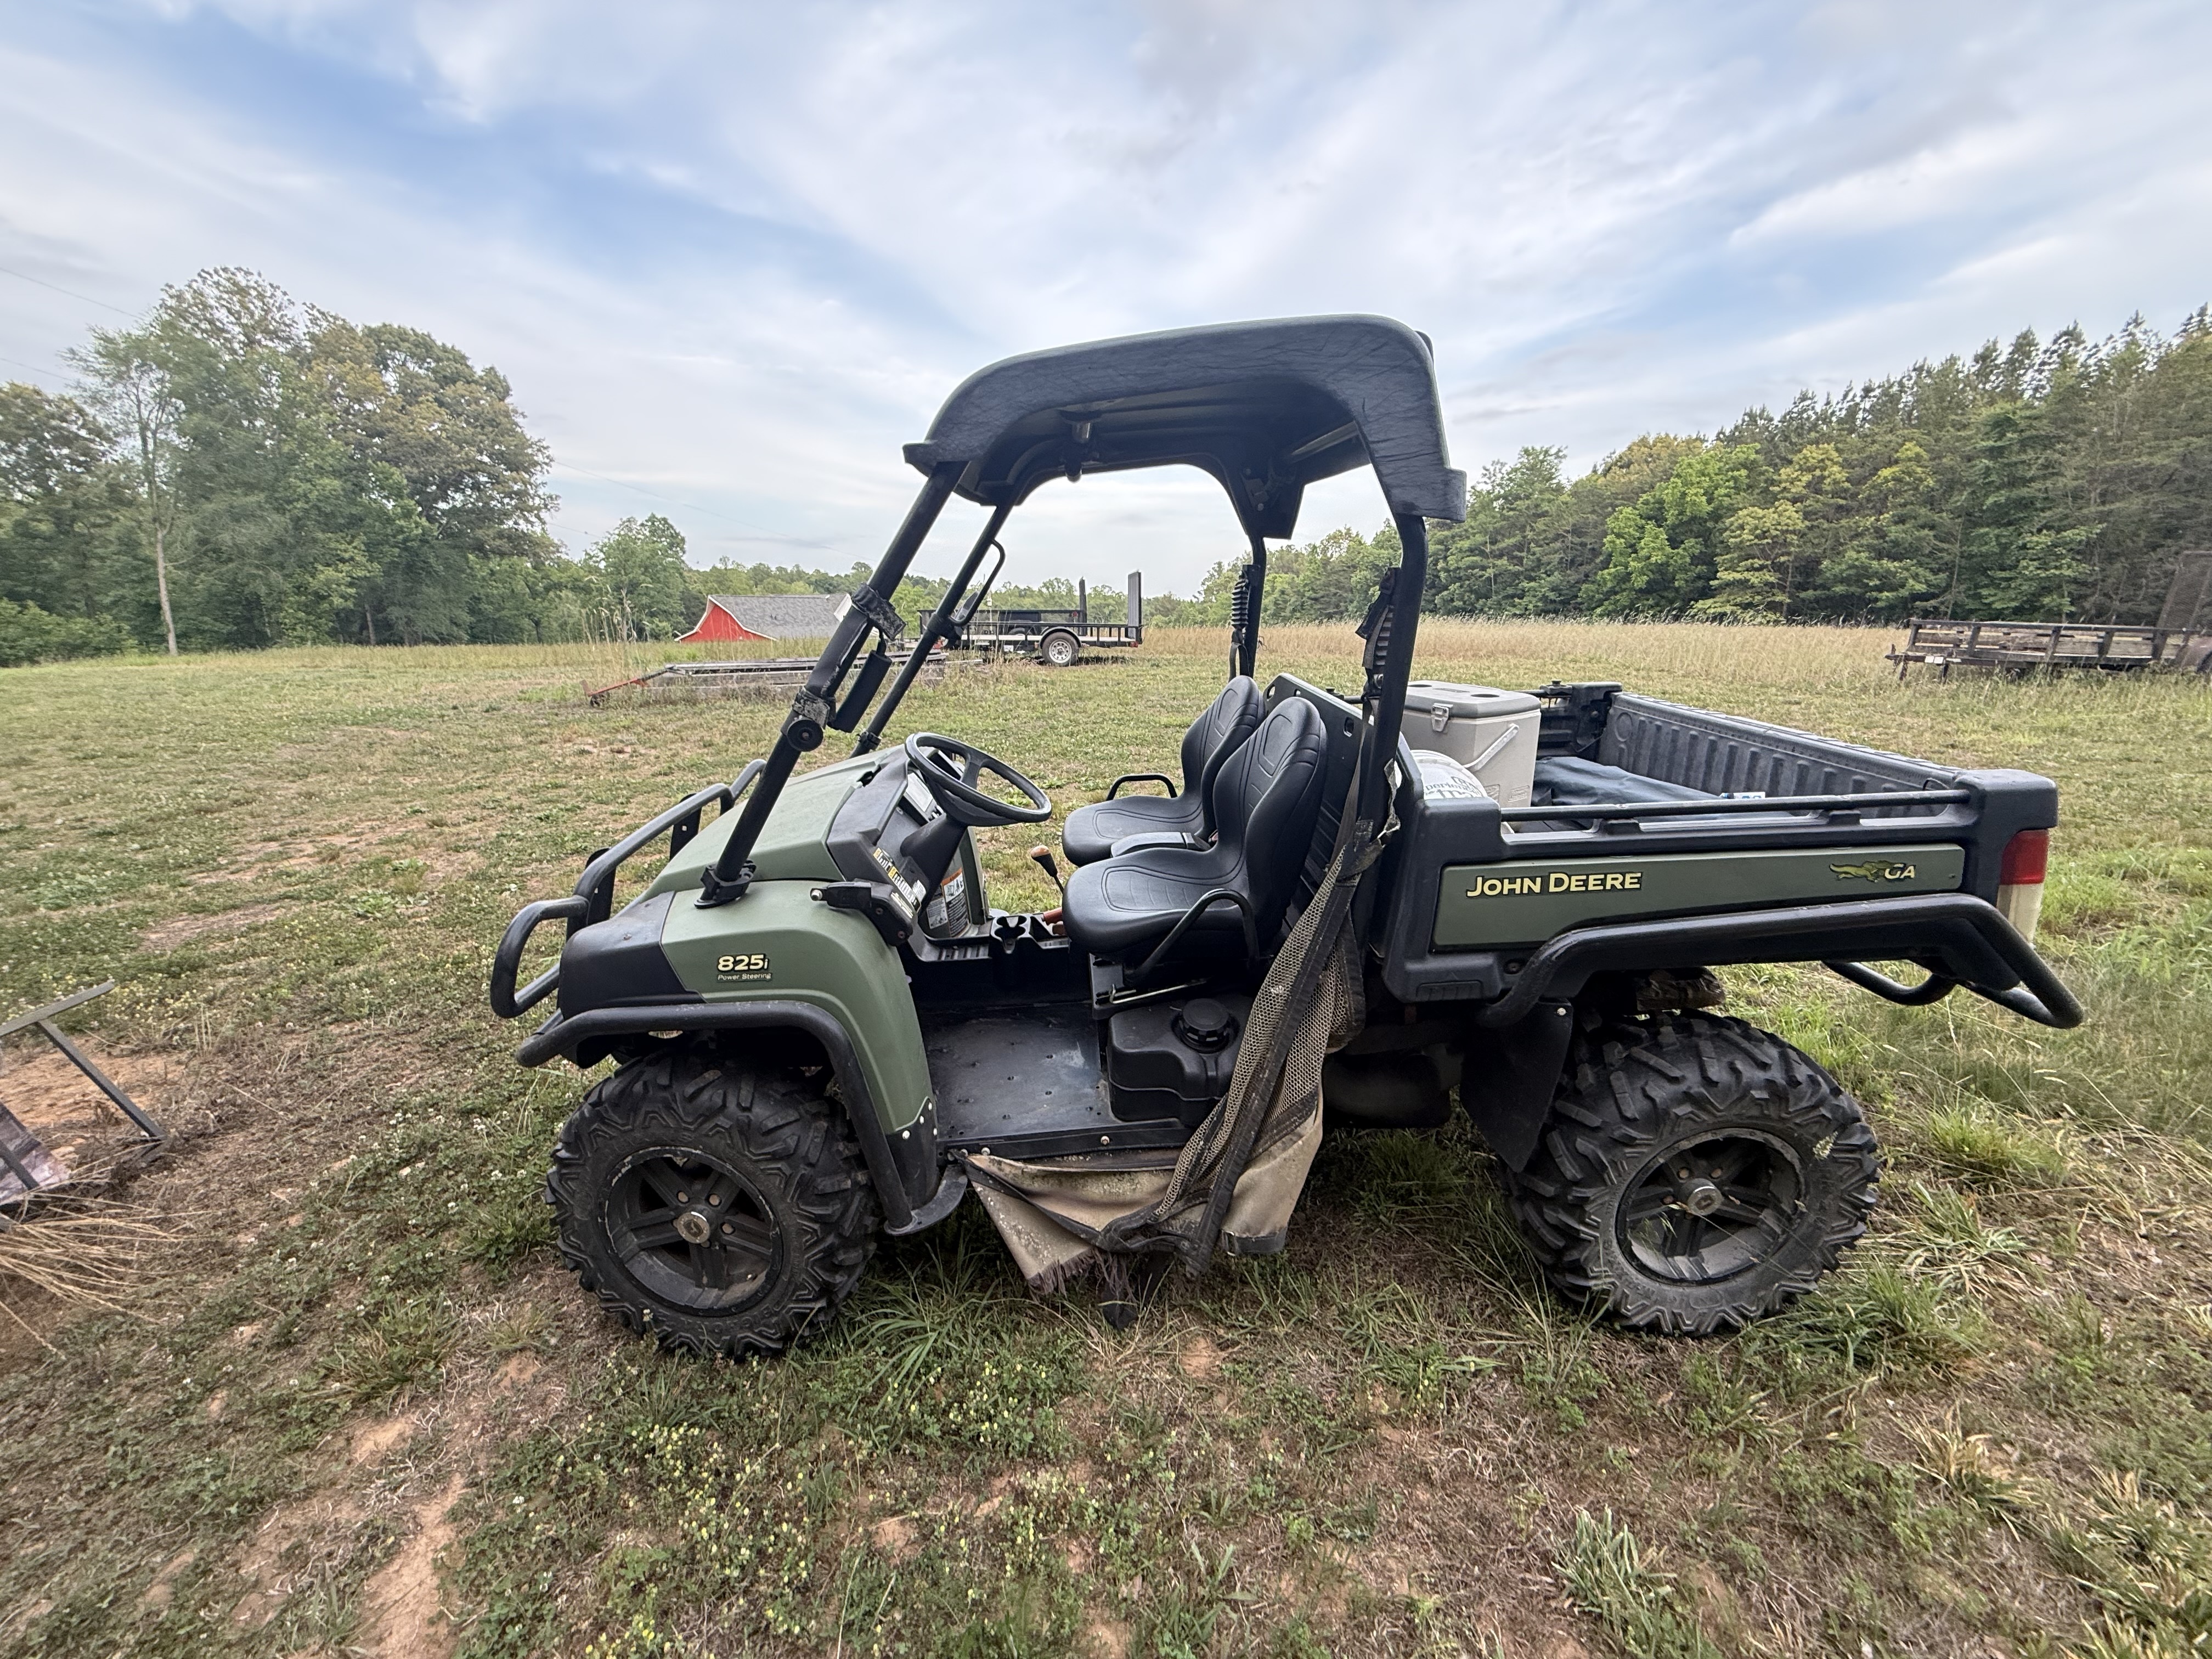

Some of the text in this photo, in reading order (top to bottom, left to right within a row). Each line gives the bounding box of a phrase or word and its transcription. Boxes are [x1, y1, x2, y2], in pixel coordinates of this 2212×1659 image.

[1884, 863, 1916, 879] GA
[1466, 872, 1642, 898] JOHN DEERE
[717, 953, 769, 972] 825i
